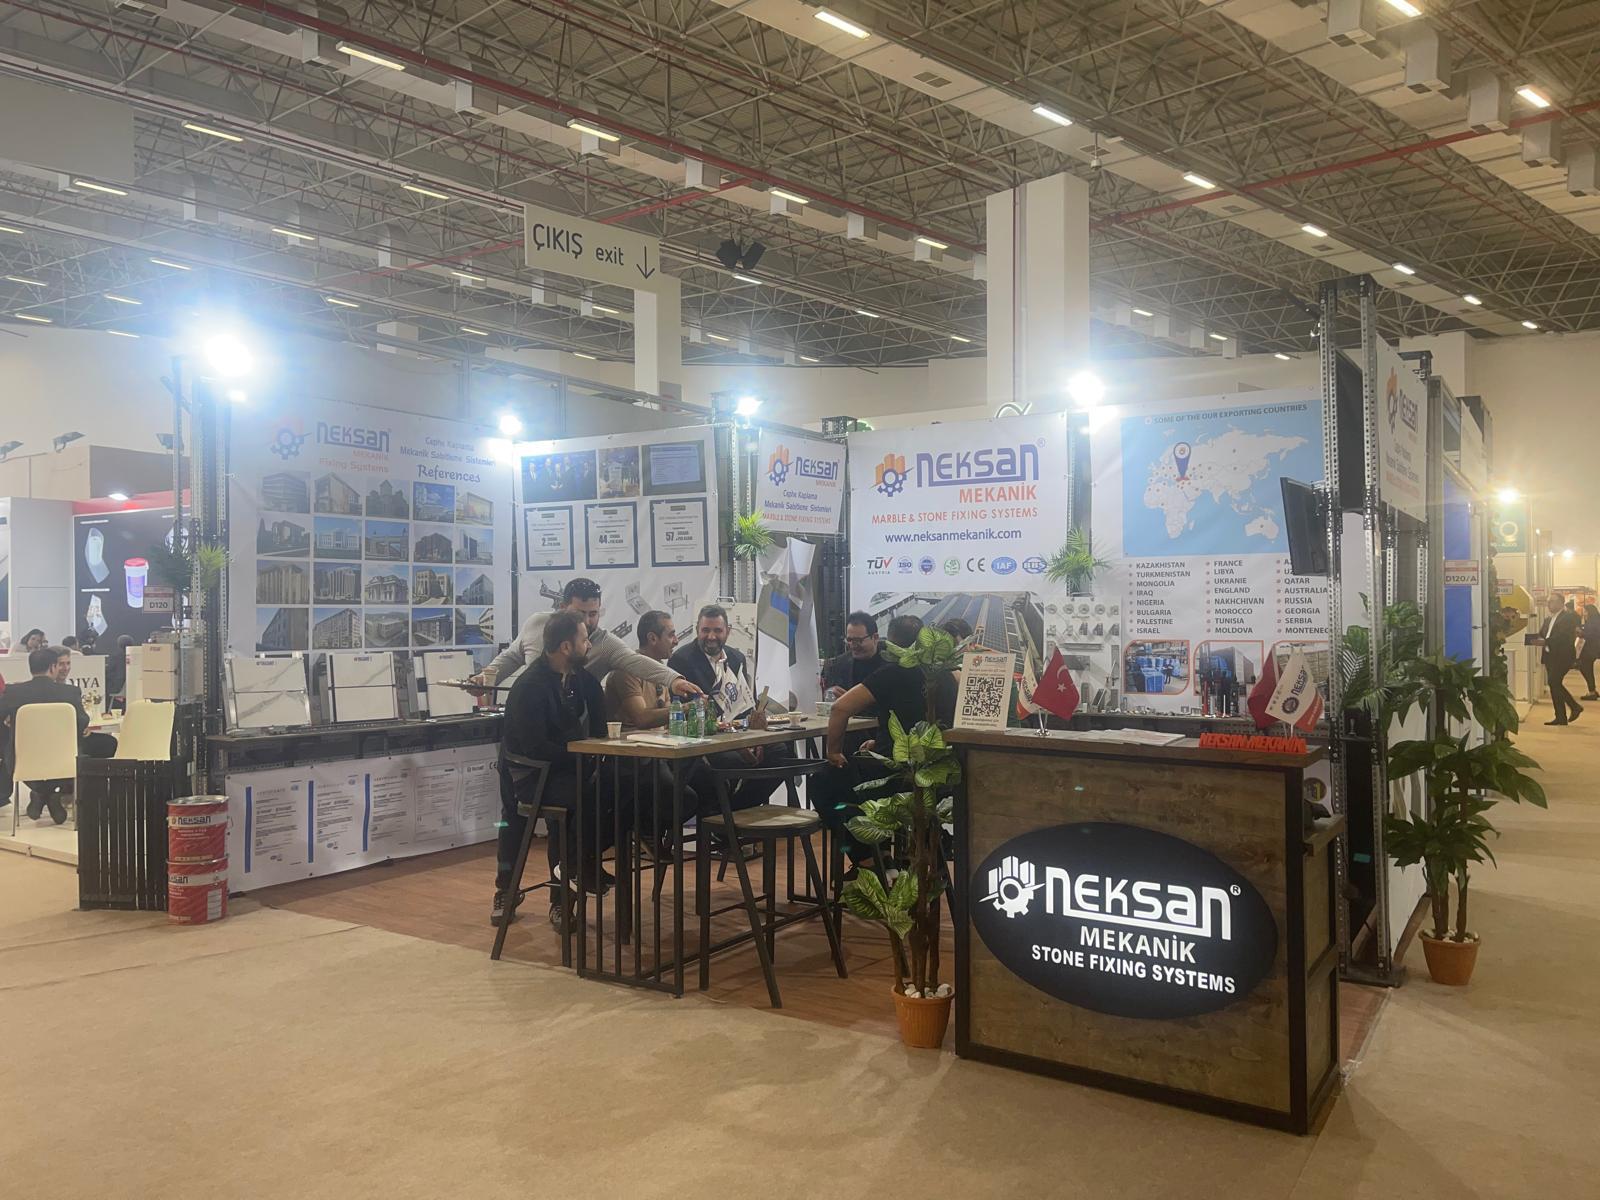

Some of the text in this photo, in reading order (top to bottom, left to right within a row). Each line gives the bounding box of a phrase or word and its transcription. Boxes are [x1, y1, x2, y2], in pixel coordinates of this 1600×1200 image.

[533, 223, 624, 266] ÇIKIŞ exit
[1202, 412, 1218, 420] OUR
[1219, 408, 1262, 418] EXPORTING
[1263, 403, 1308, 414] COUNTRIES
[417, 464, 481, 483] References
[959, 482, 1038, 504] MEKANİK
[871, 507, 1038, 525] MARBLE & STONE FIXING SYSTEMS
[885, 527, 1022, 543] www.neksanmekanik.com
[899, 561, 912, 569] ISO
[995, 561, 1012, 570] IAF
[1136, 570, 1191, 578] TURKMENISTAN
[1284, 577, 1310, 585] QATAR
[1136, 589, 1153, 597] IRAQ
[1214, 597, 1264, 605] NAKHCHIVAN
[149, 601, 168, 609] D120
[1080, 925, 1196, 964] MEKANİK
[1031, 944, 1236, 994] STONE FIXING SYSTEMS
